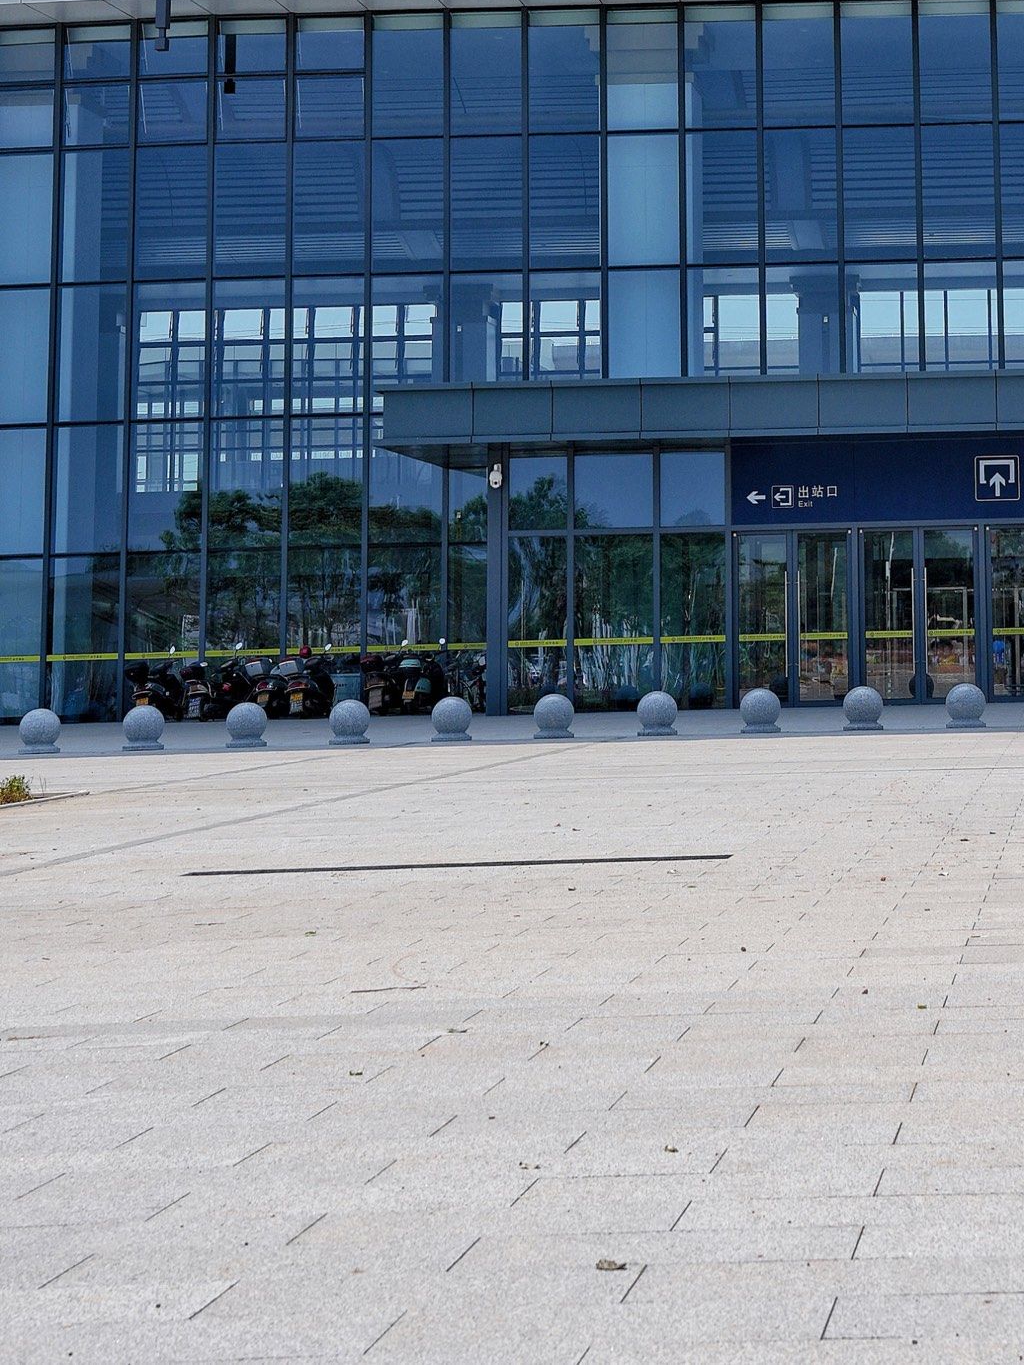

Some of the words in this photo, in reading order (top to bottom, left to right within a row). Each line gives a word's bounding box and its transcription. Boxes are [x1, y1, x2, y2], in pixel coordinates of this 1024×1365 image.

[798, 484, 838, 498] 出站口
[798, 500, 813, 508] Exit
